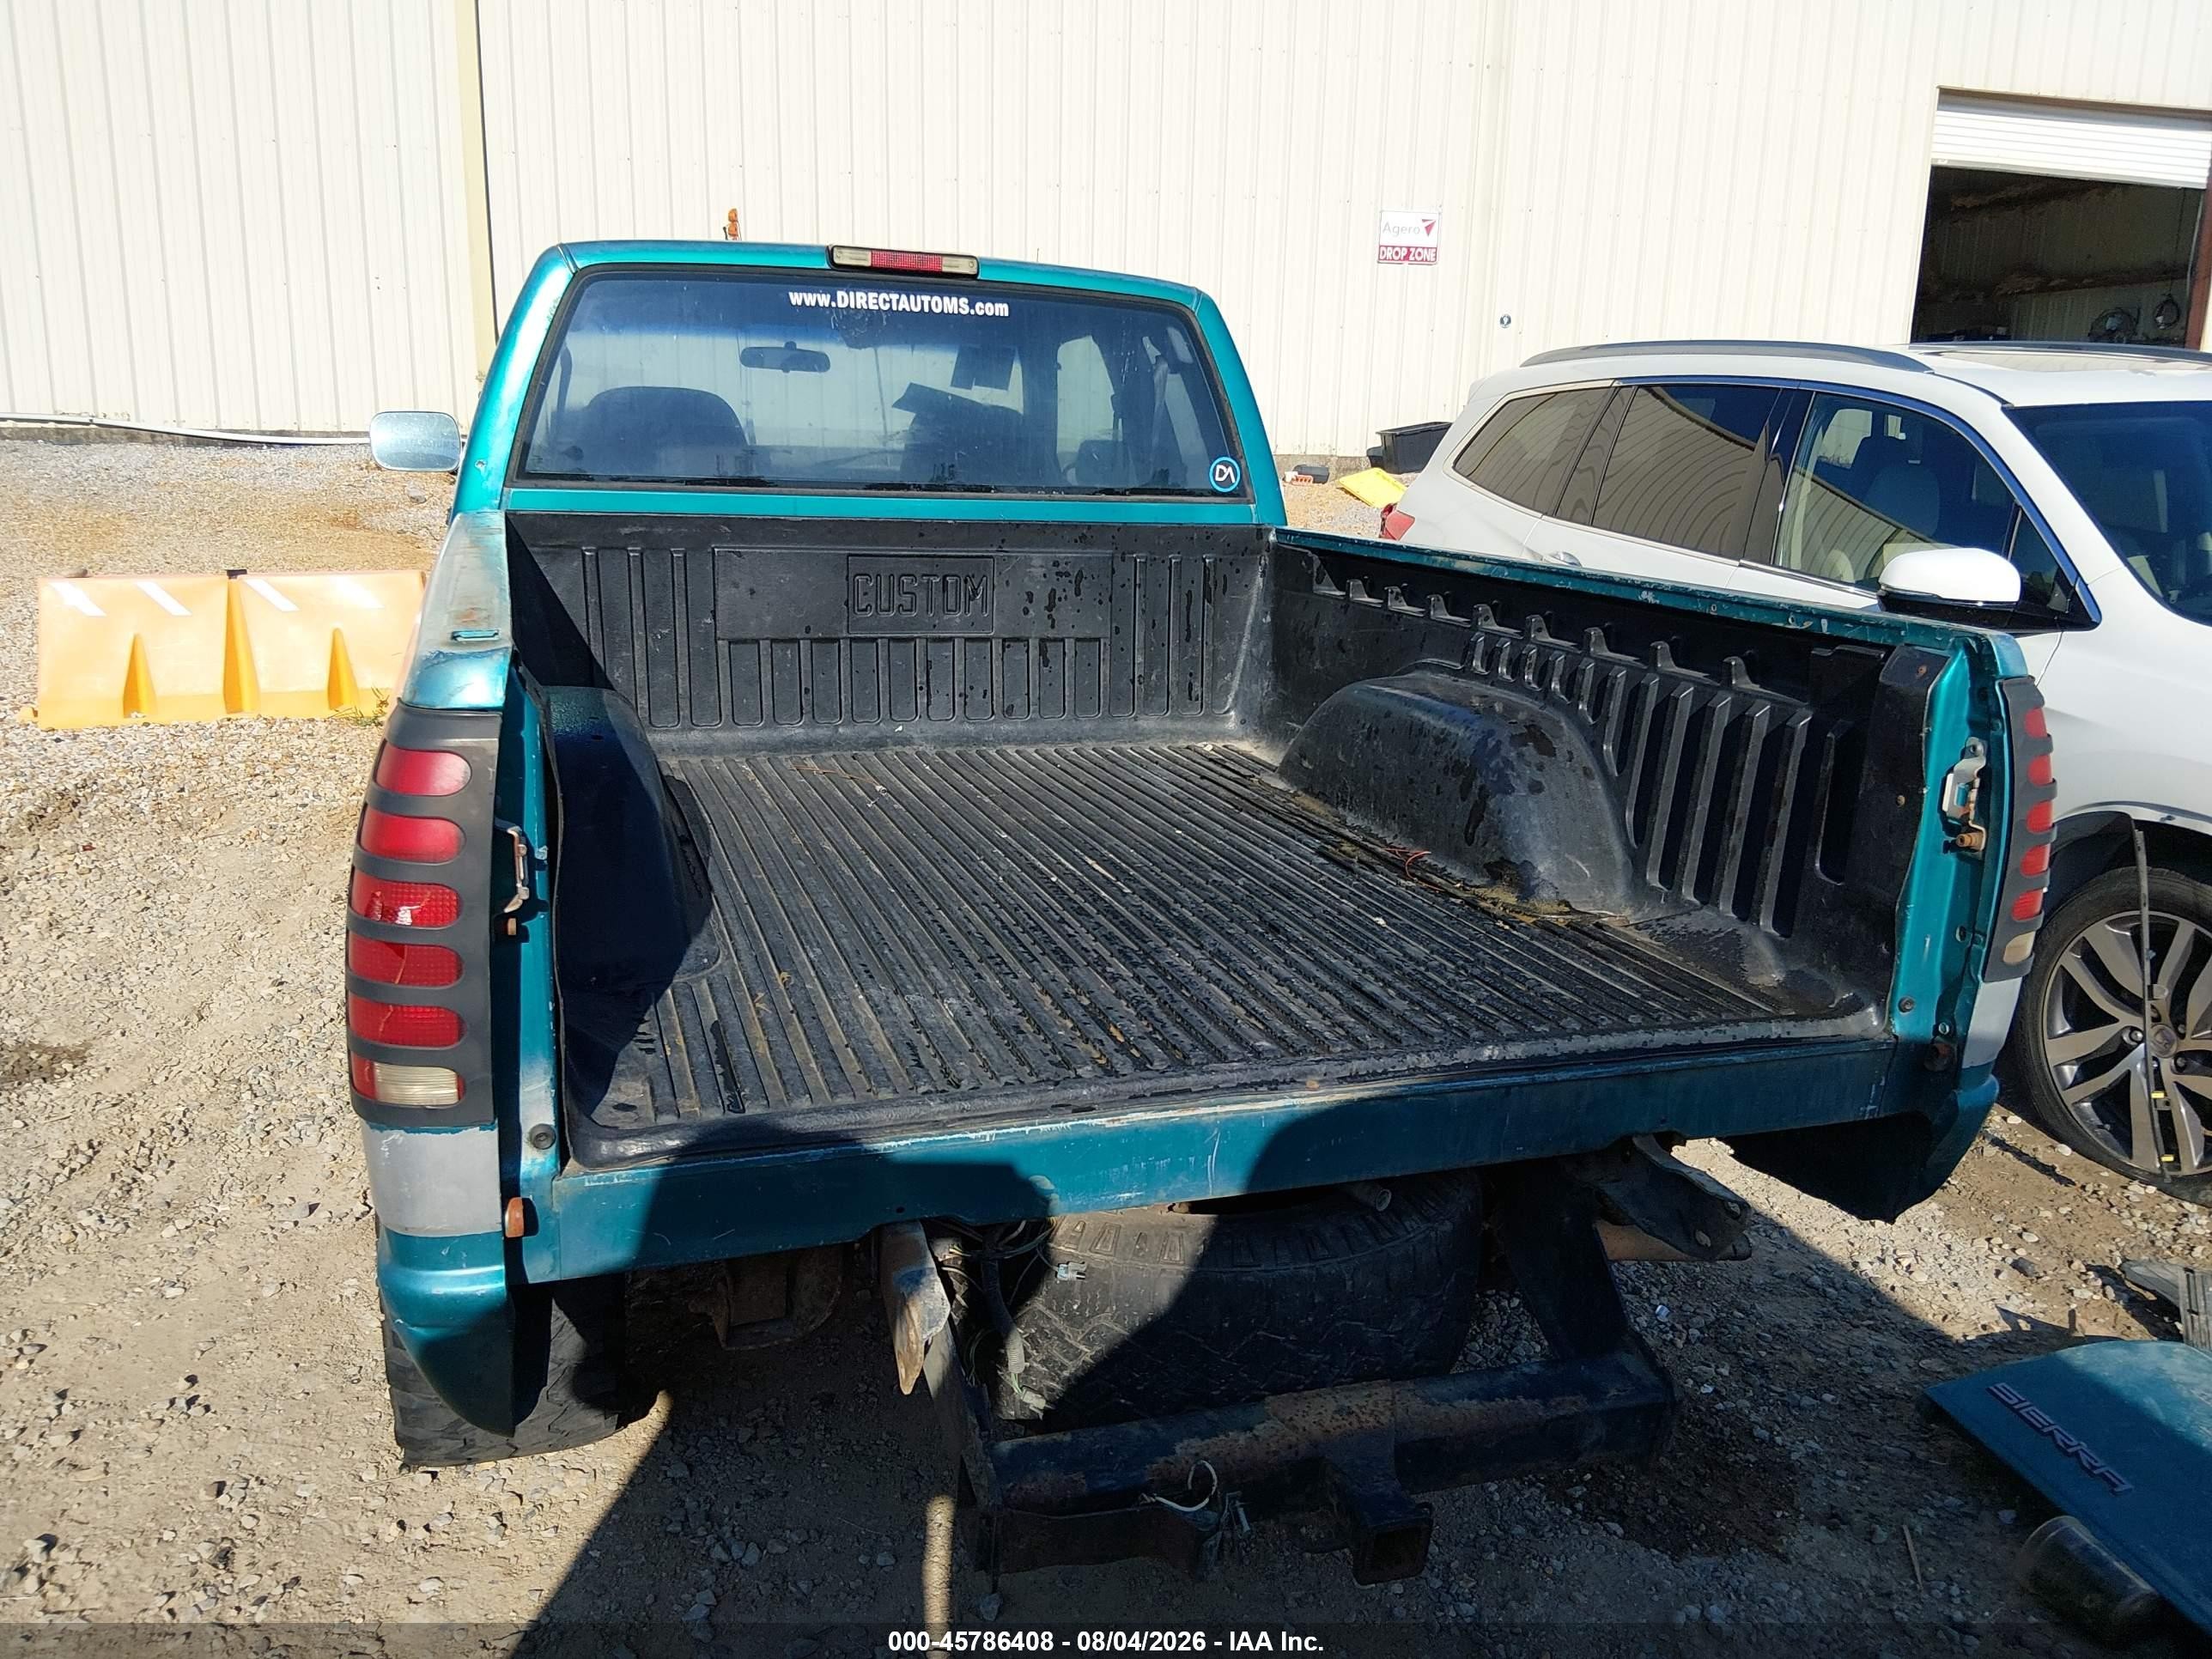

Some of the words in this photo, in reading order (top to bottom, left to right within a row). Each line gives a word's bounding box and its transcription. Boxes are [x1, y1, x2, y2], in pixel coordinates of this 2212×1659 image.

[1382, 222, 1420, 237] Agero
[1379, 246, 1407, 261] DROP
[1409, 247, 1437, 262] ZONE
[788, 290, 1009, 317] www.DIRECTAUTOMS.com
[854, 574, 988, 617] CUSTOM
[1985, 1382, 2134, 1496] SIERRA
